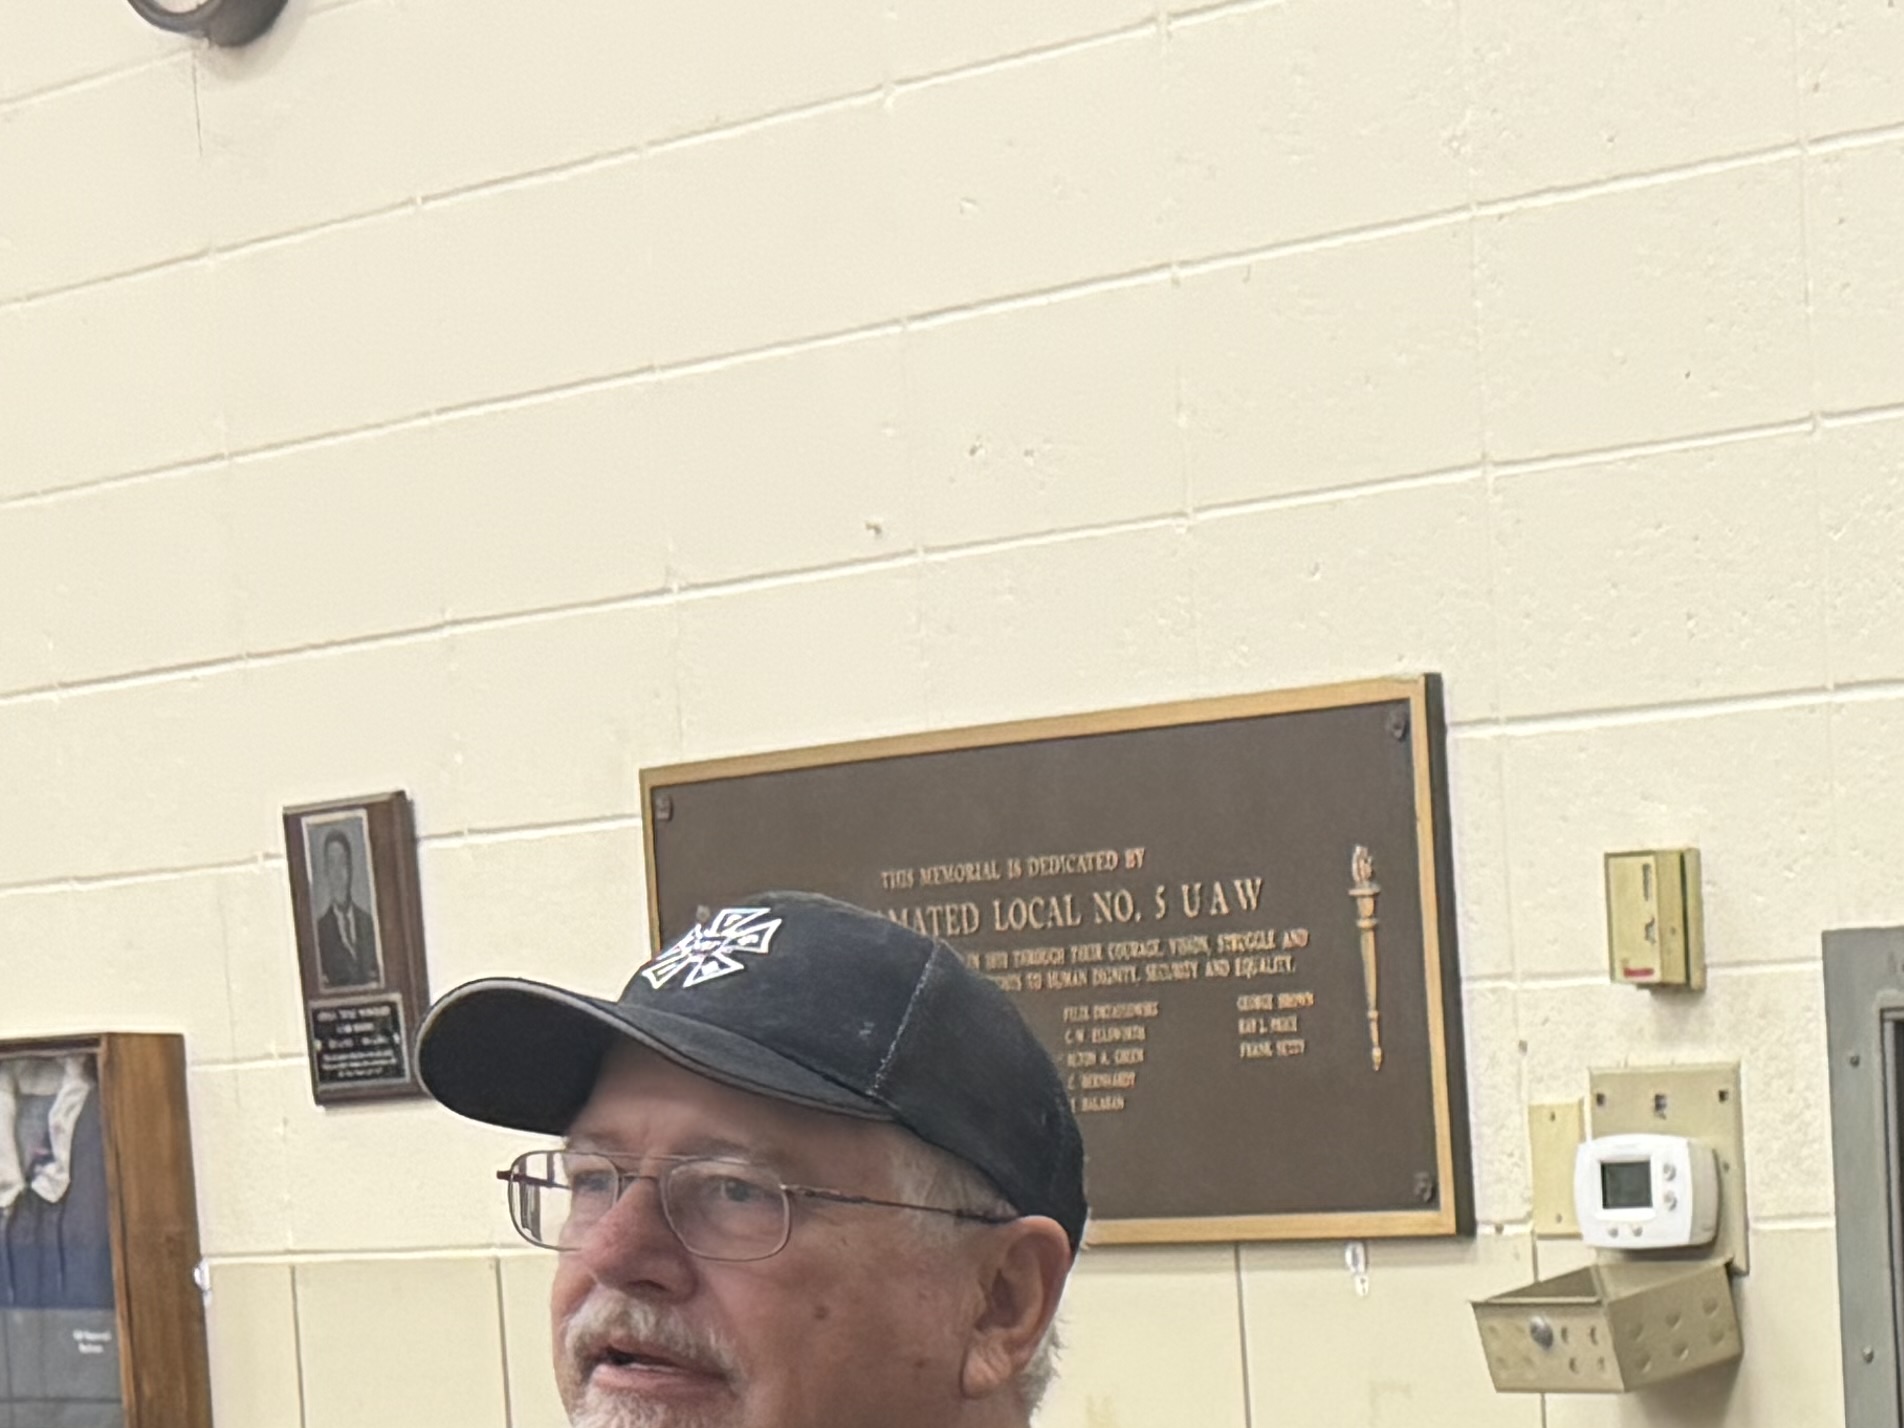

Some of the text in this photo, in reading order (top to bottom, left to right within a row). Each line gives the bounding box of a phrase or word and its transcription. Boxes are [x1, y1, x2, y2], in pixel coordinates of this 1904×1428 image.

[881, 847, 1146, 890] THIS MEMORIAL IS DEDICATED BY
[876, 900, 981, 938] MATED
[993, 893, 1082, 932] LOCAL
[1093, 888, 1143, 925] NO.
[1155, 884, 1168, 920] 5
[1282, 927, 1310, 949] AND
[1205, 957, 1231, 978] AND
